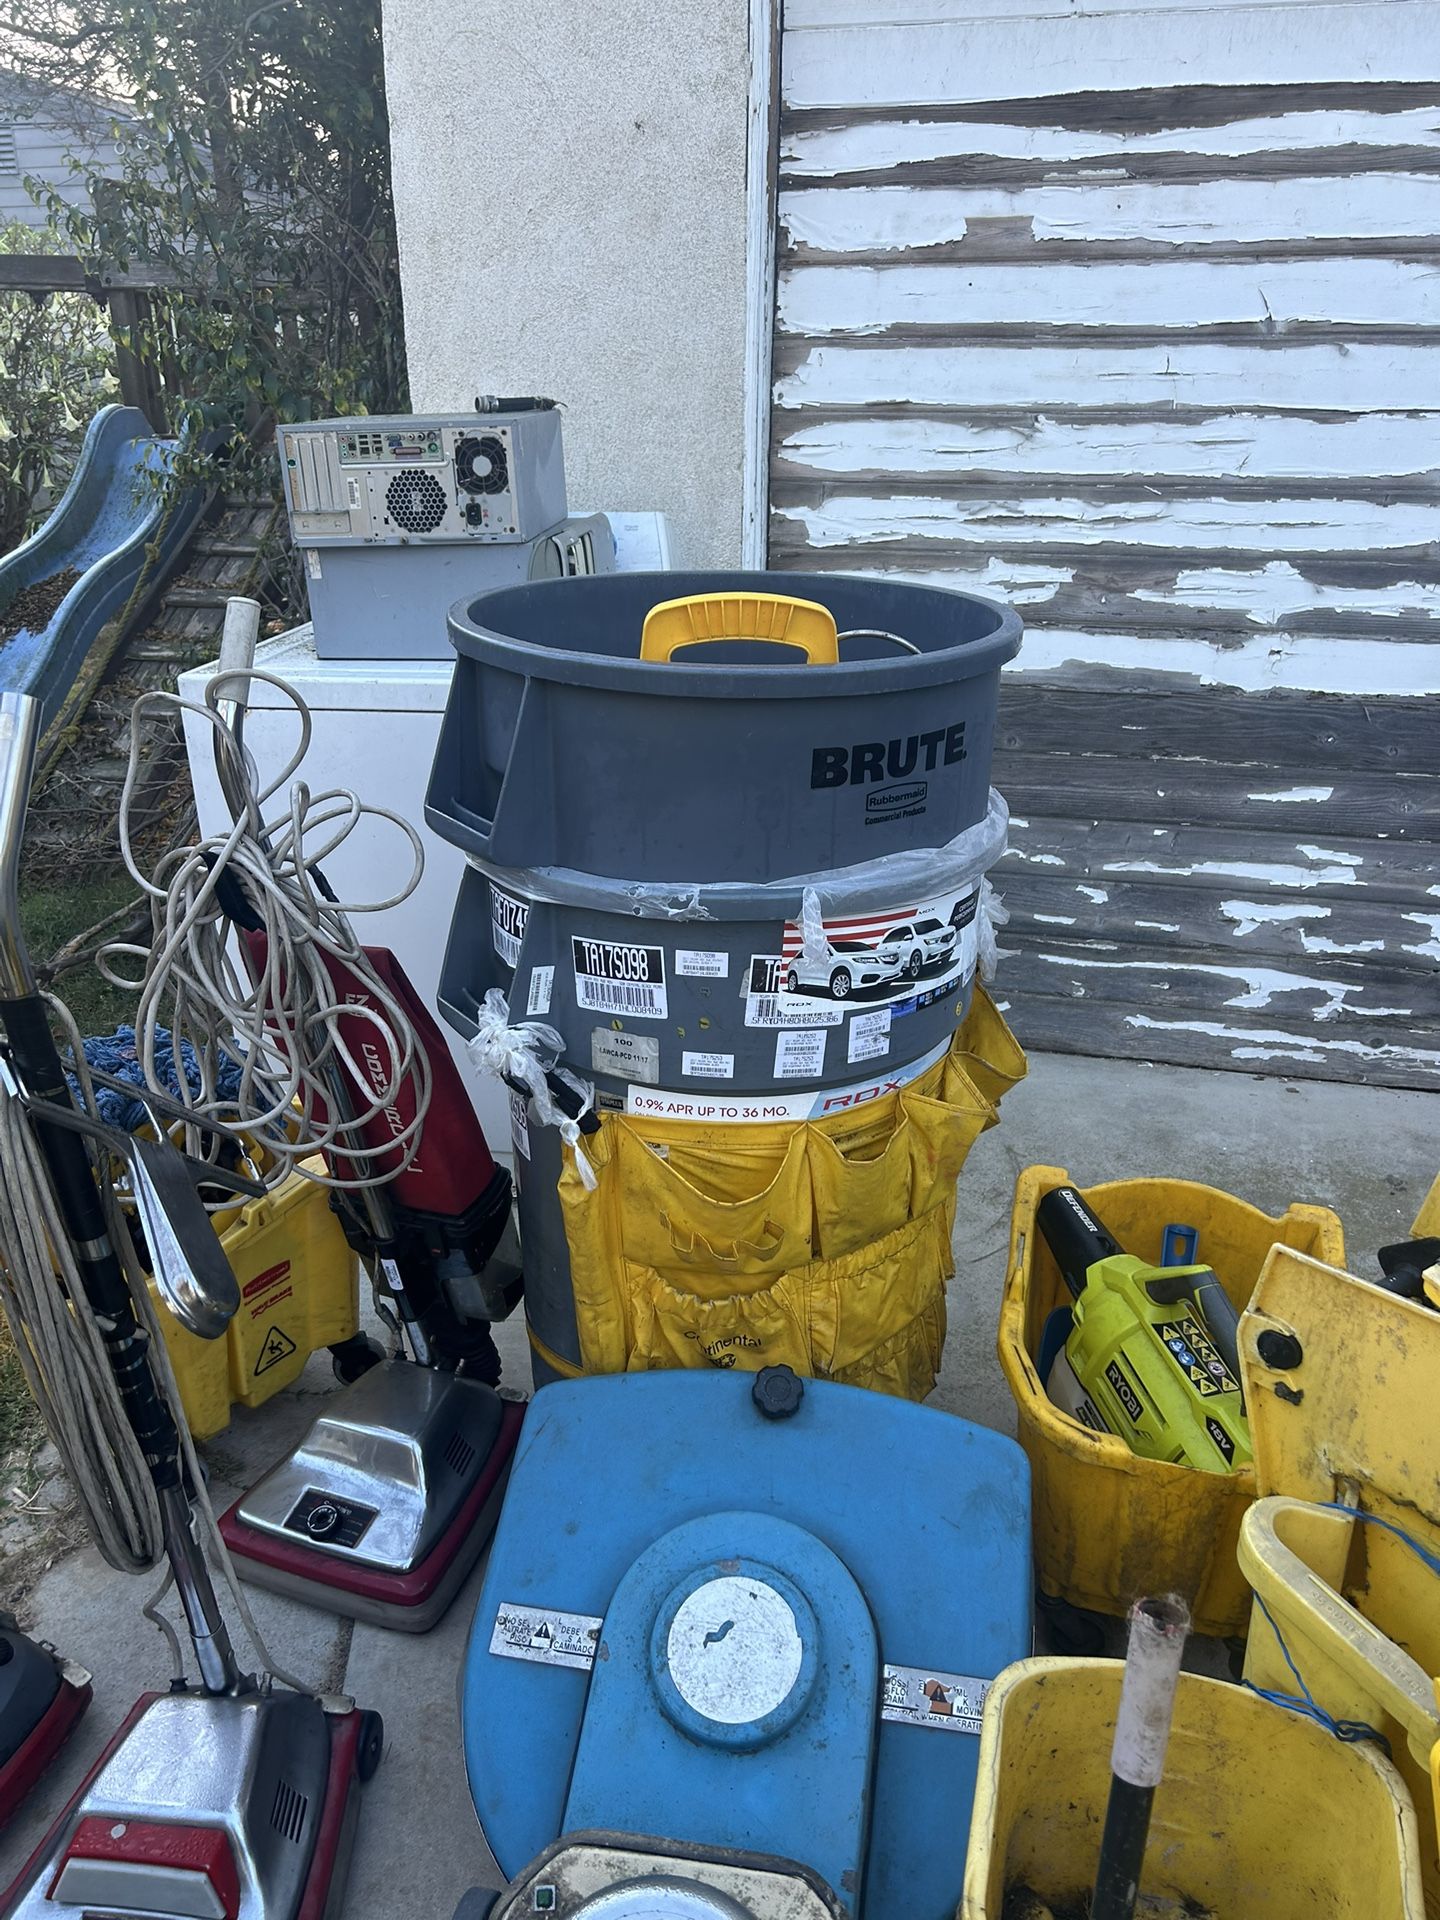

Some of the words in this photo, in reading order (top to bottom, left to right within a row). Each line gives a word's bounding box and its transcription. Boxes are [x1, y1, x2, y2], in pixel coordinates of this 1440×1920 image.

[811, 721, 966, 789] BRUTE
[868, 786, 926, 807] Rubbermaid
[865, 811, 901, 825] Commercial
[902, 805, 926, 819] Products
[614, 1038, 633, 1047] 100
[635, 1096, 664, 1112] 0.9%
[666, 1103, 693, 1116] APR
[697, 1106, 715, 1117] UP
[719, 1107, 738, 1118] TO
[742, 1107, 758, 1118] 36
[763, 1106, 789, 1117] MO.
[823, 1077, 904, 1111] RDX
[1060, 1190, 1099, 1232] DEFENDER
[1109, 1365, 1140, 1417] RYOBI
[1210, 1422, 1231, 1449] 18V
